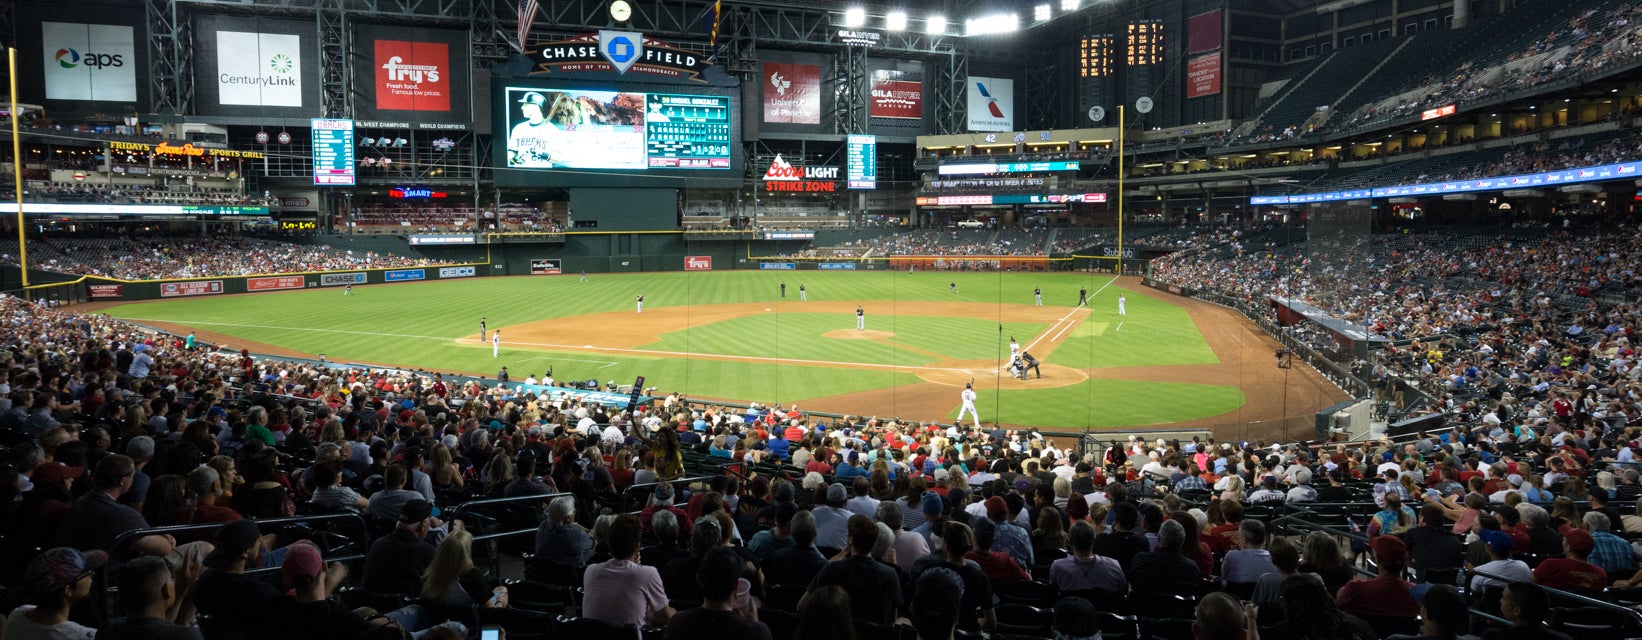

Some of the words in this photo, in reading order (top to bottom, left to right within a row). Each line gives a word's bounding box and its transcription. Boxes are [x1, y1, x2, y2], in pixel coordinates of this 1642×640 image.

[84, 53, 123, 69] aps
[543, 46, 596, 58] CHASE
[647, 51, 696, 67] FIELD
[382, 56, 439, 83] fry's
[633, 67, 678, 76] DIAMONDBACKS
[220, 73, 295, 86] CenturyLink
[986, 134, 997, 142] 42
[110, 141, 150, 151] FRIDAY'S
[209, 149, 240, 157] SPORTS
[767, 162, 805, 178] Coors
[806, 167, 838, 178] LIGHT
[766, 181, 803, 191] STRIKE
[806, 181, 834, 191] ZONE
